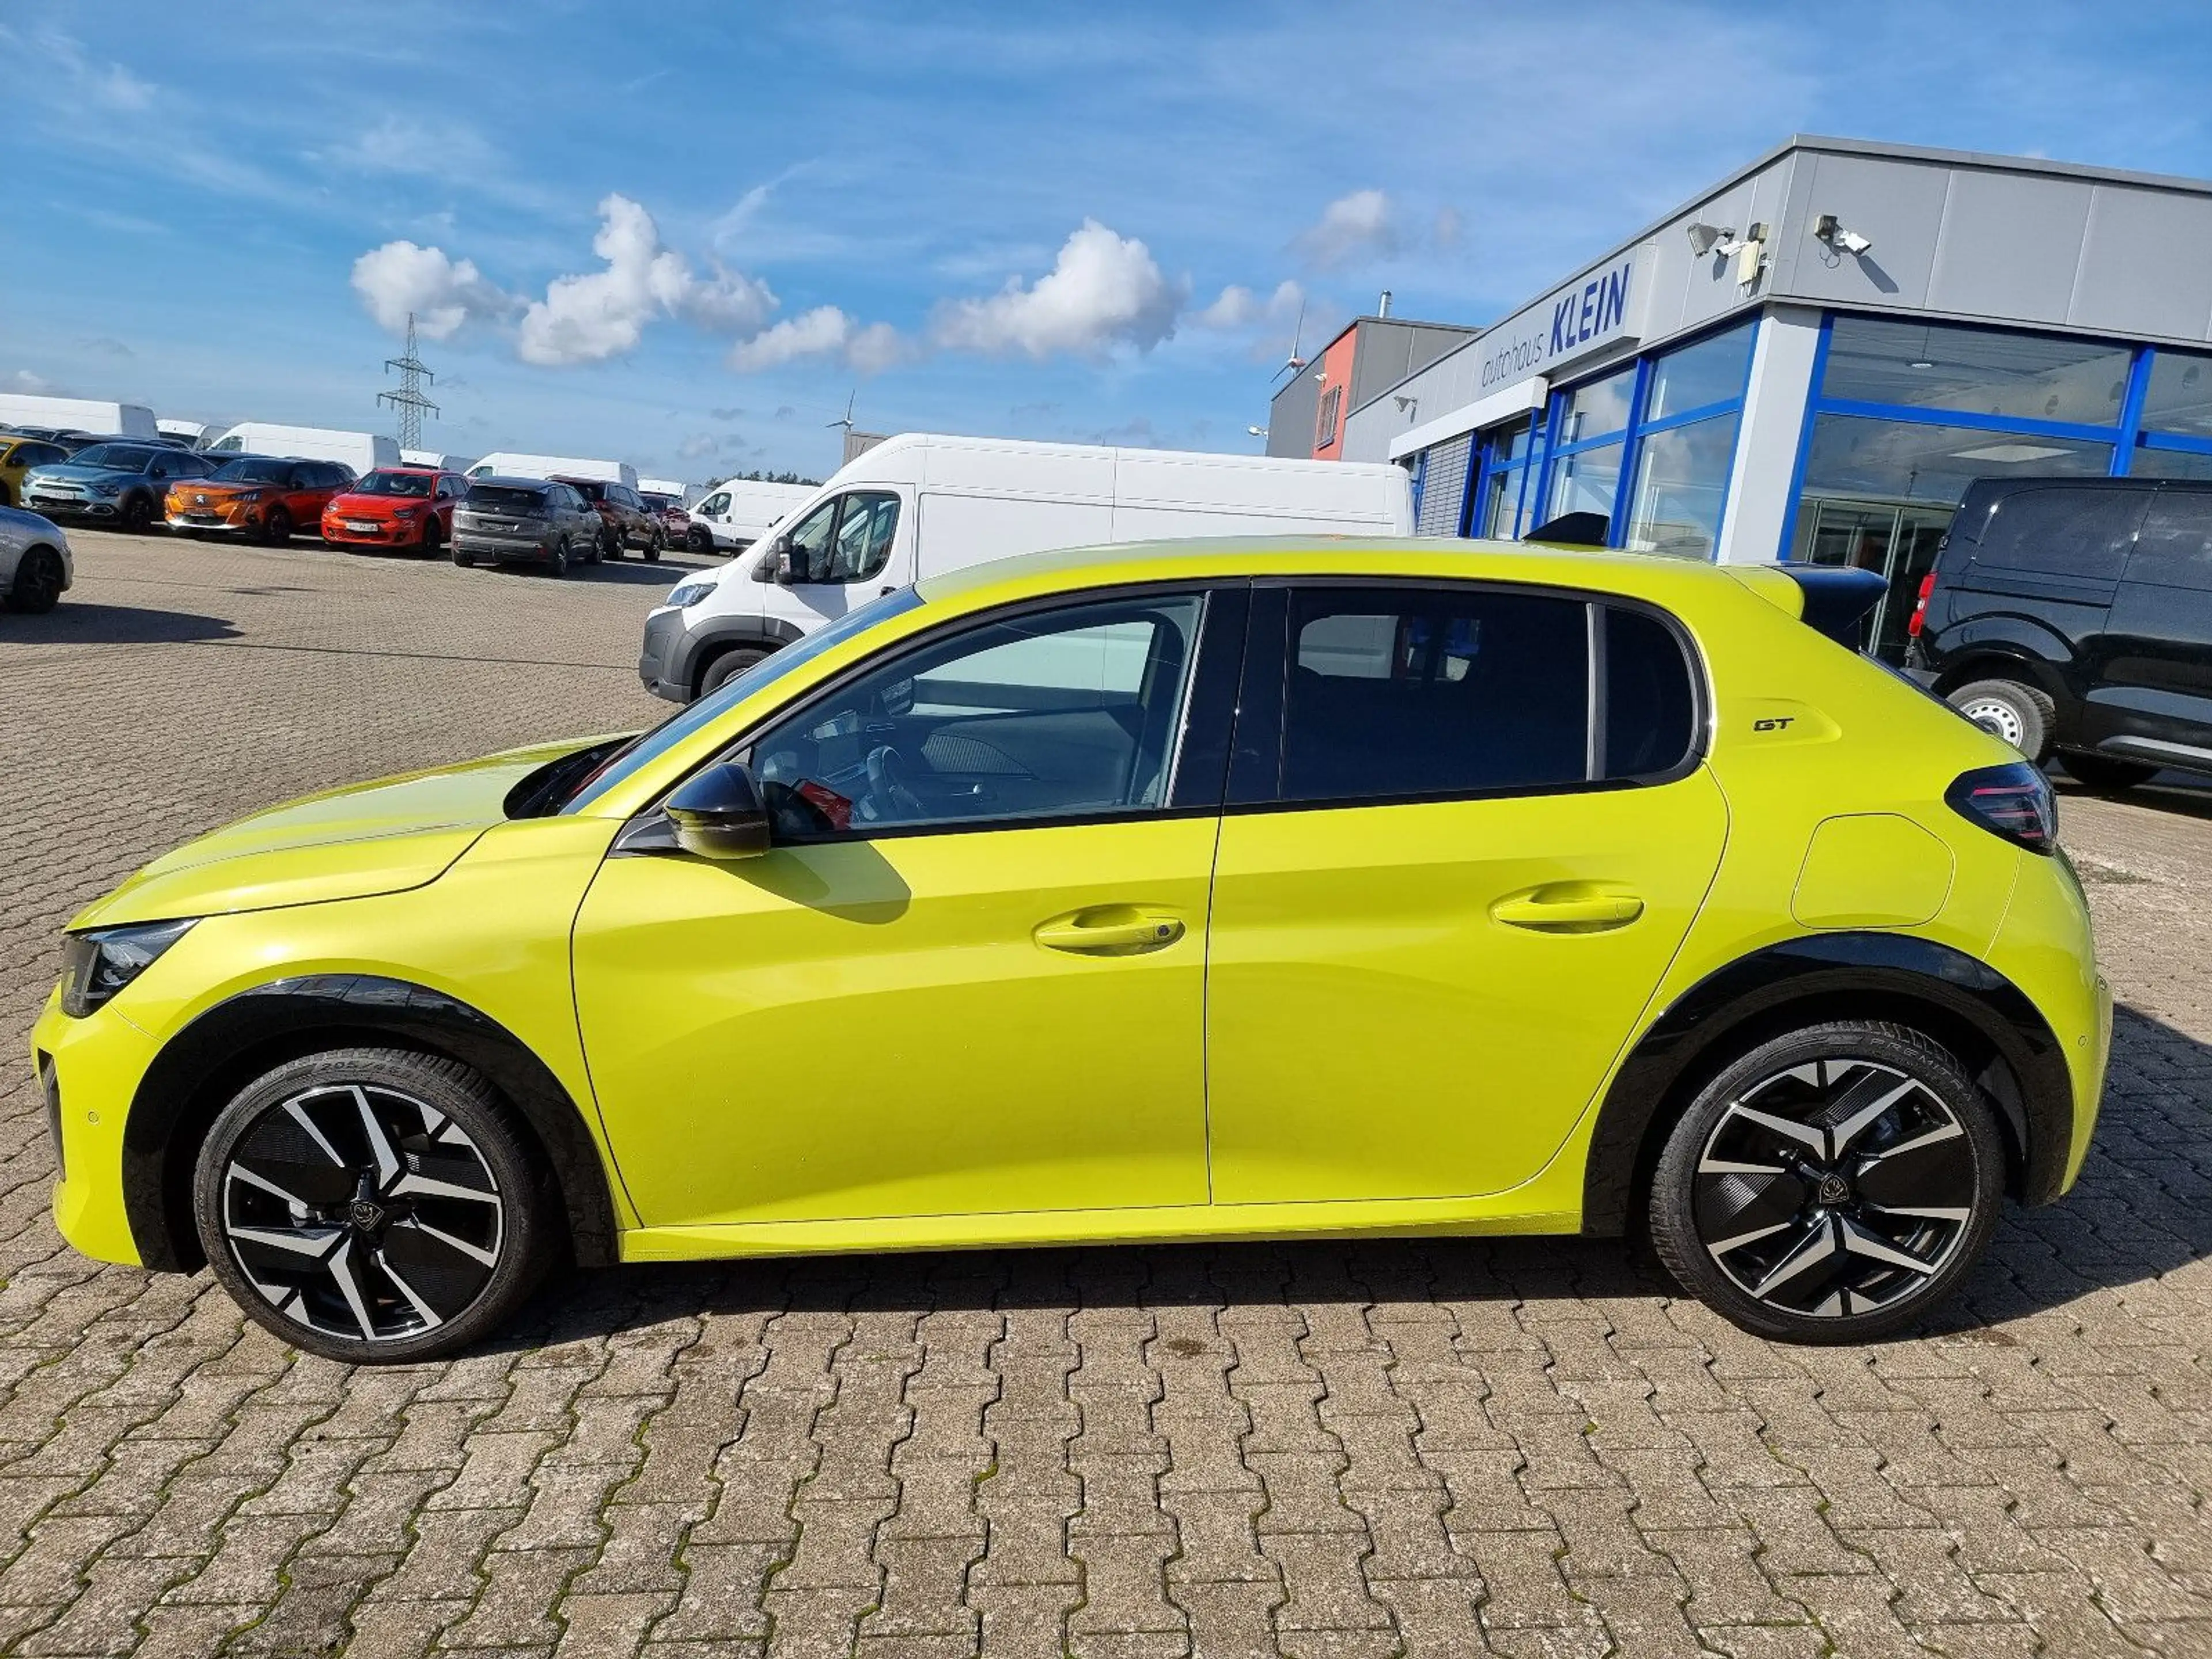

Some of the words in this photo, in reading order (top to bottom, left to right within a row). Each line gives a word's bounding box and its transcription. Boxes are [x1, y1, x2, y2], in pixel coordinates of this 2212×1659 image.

[1482, 333, 1544, 388] autohaus
[1548, 263, 1631, 357] KLEIN
[1753, 717, 1794, 732] GT
